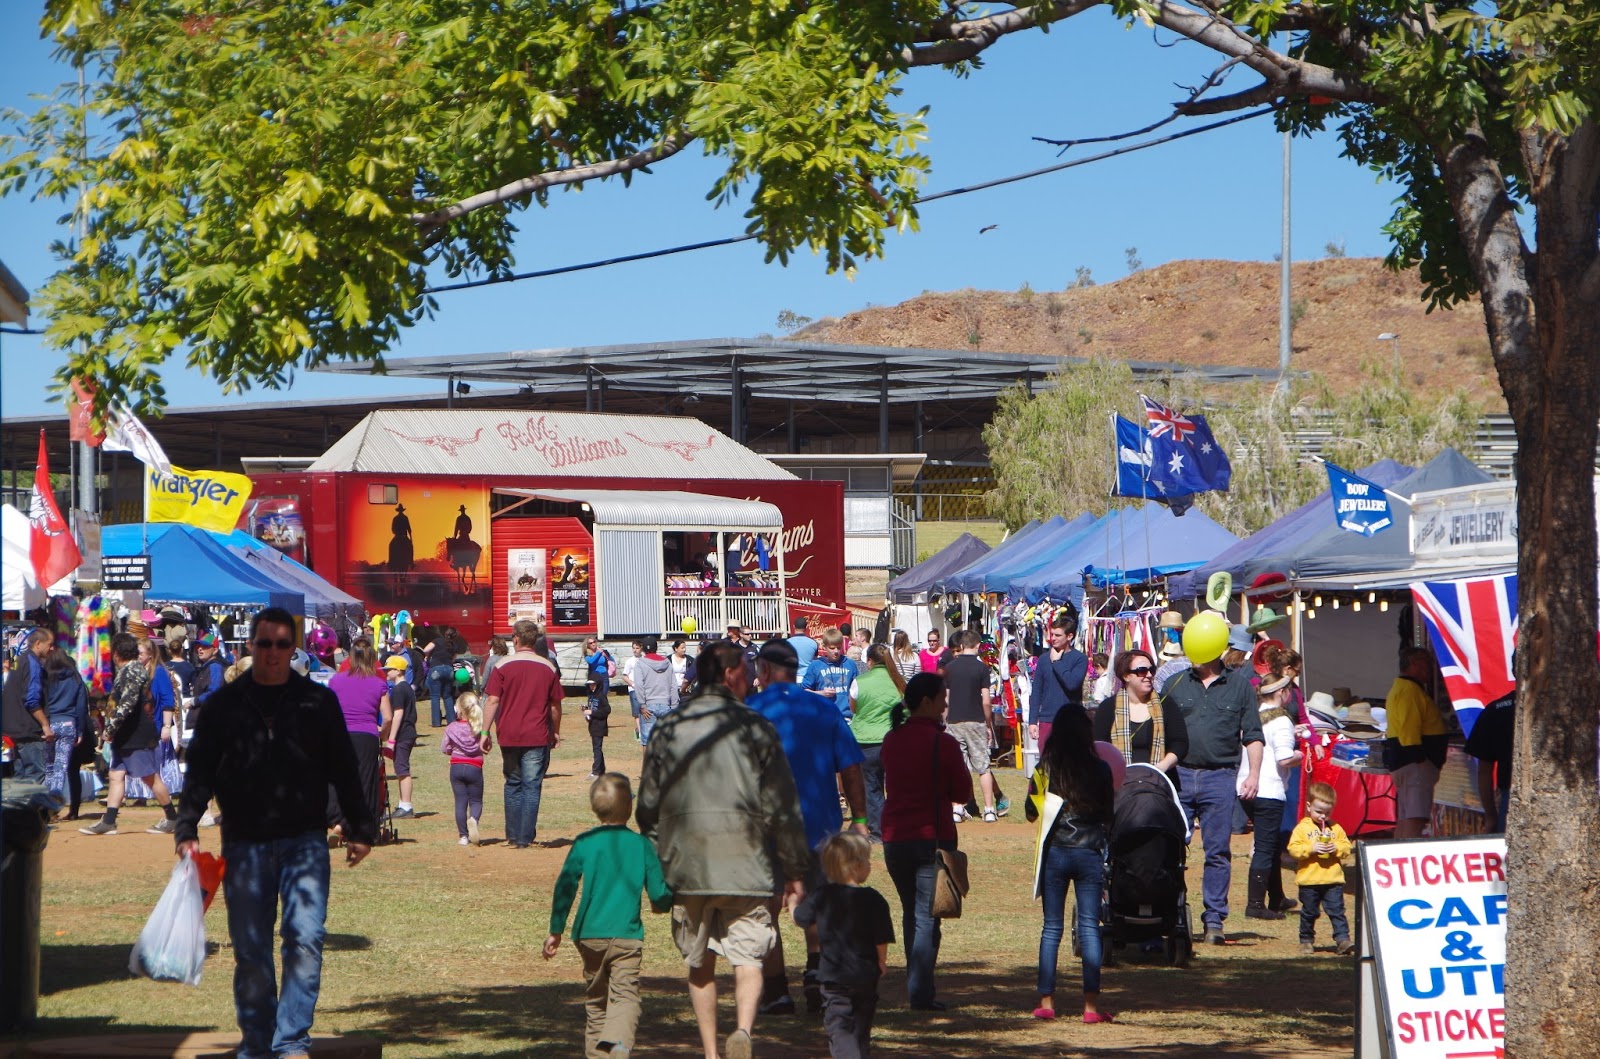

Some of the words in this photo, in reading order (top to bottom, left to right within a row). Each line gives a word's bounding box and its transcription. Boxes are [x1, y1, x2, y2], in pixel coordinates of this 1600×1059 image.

[534, 436, 628, 469] Williams
[1346, 482, 1369, 496] BODY
[1337, 498, 1387, 513] JEWELLERY
[1449, 511, 1505, 546] JEWELLERY
[1374, 852, 1508, 889] STICKER
[1440, 930, 1487, 962] &
